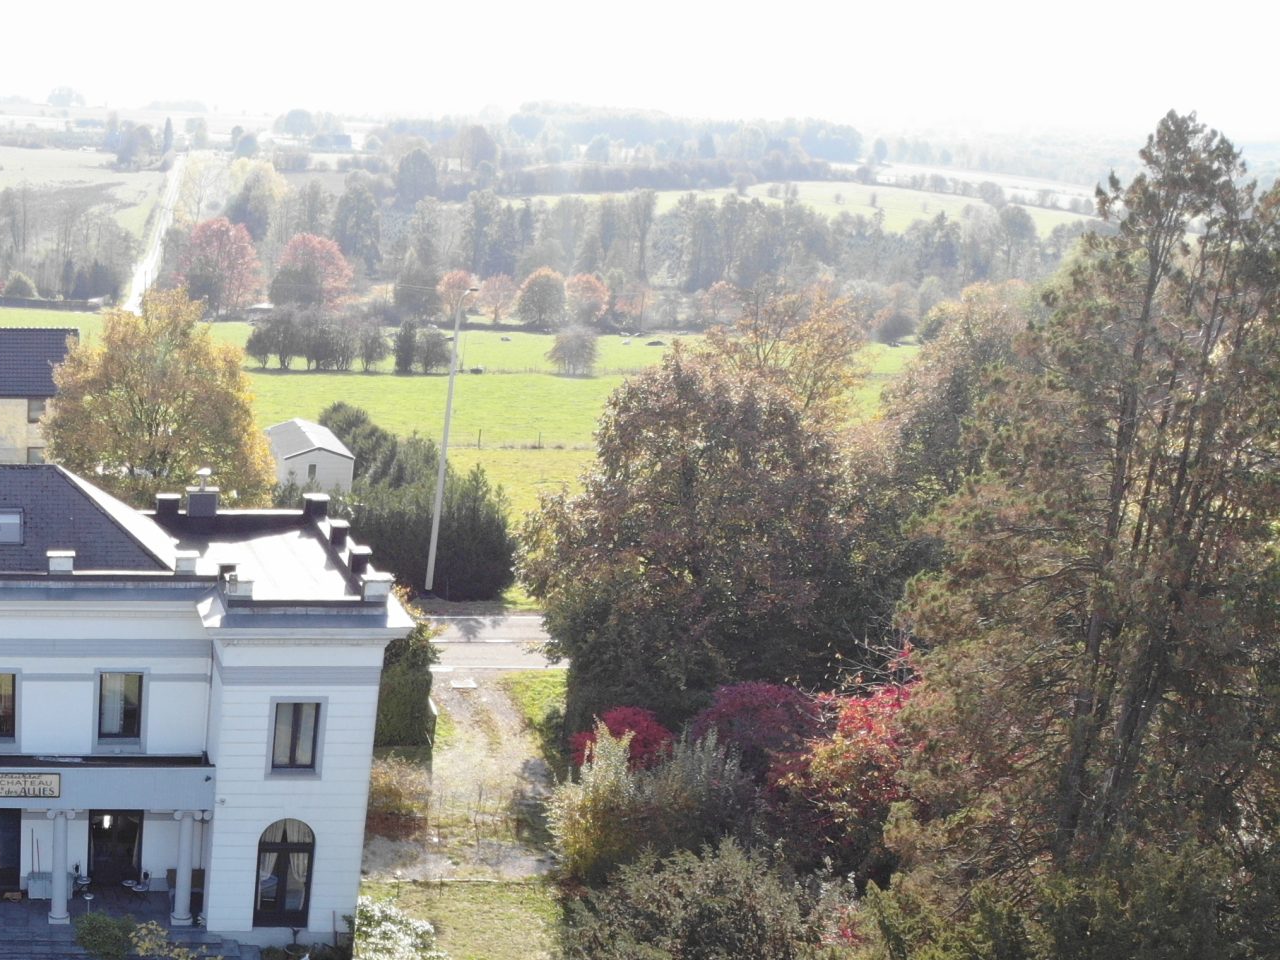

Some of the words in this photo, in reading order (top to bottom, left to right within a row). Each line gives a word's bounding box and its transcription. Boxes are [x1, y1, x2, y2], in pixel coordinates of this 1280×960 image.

[0, 779, 53, 787] CHATEAU
[5, 787, 18, 795] des
[19, 786, 55, 796] ALLIES
